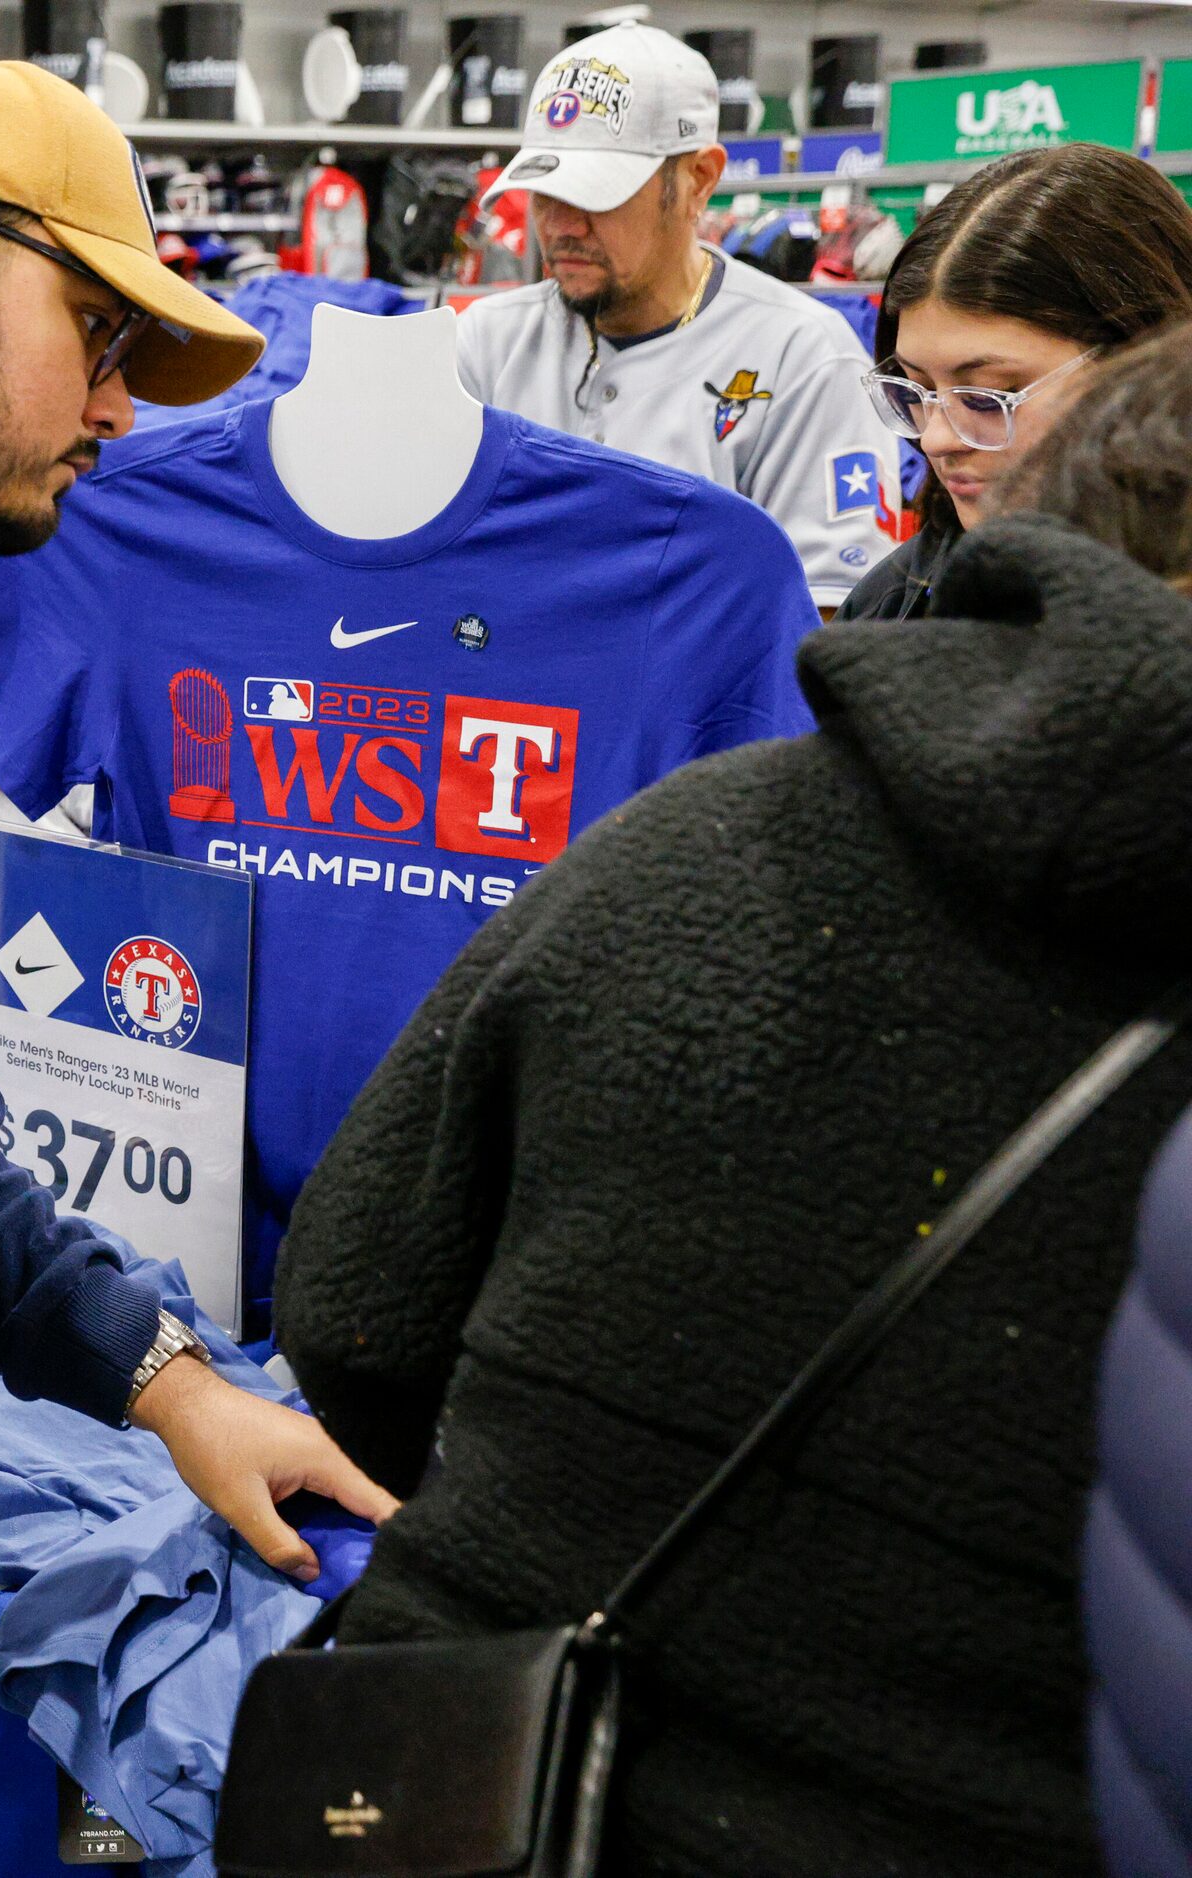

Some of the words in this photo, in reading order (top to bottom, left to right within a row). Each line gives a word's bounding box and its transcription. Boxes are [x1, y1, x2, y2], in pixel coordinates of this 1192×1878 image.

[554, 96, 575, 122] T
[572, 67, 631, 135] SERIES
[318, 691, 430, 724] 2023
[244, 724, 426, 832] WS
[459, 716, 561, 838] T
[207, 838, 516, 907] CHAMPIONS
[118, 943, 188, 979] TEXAS
[110, 994, 194, 1046] RANGERS
[135, 970, 170, 1023] T
[6, 1052, 42, 1073] Series
[45, 1062, 85, 1087] Trophy
[89, 1074, 134, 1098] Lockup
[137, 1087, 181, 1111] T-Shirts
[20, 1040, 54, 1060] Men's
[57, 1050, 108, 1074] Rangers
[111, 1064, 130, 1080] '23
[133, 1070, 160, 1088] MLB
[162, 1078, 200, 1099] World
